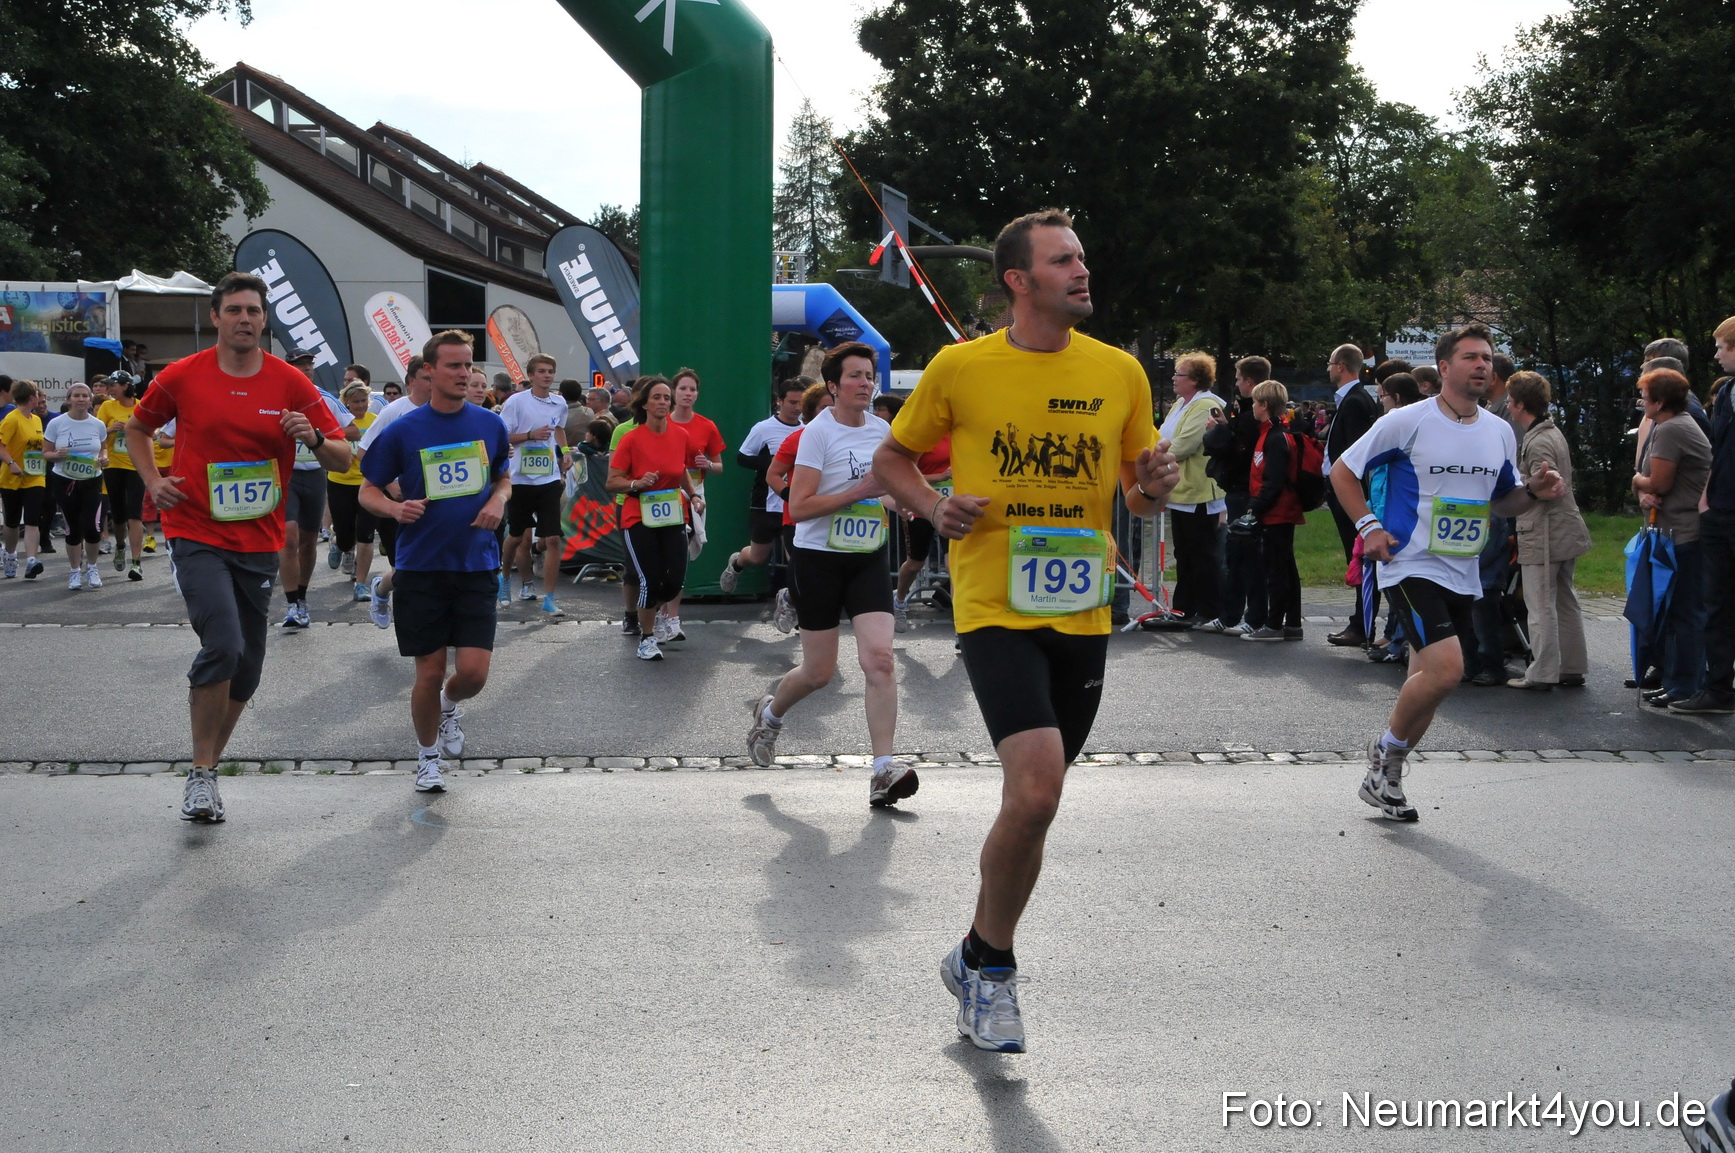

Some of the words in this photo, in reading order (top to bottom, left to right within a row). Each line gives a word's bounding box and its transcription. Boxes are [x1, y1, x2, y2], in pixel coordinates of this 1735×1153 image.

[21, 315, 91, 336] Logistics
[1047, 398, 1088, 410] swn
[26, 459, 40, 470] 181
[65, 461, 93, 475] 1006
[522, 456, 549, 468] 1360
[438, 461, 469, 484] 85
[1429, 465, 1498, 477] DELPHI
[213, 481, 272, 505] 1157
[440, 483, 465, 491] Christian
[223, 504, 251, 513] Christian
[651, 502, 671, 518] 60
[1005, 503, 1045, 517] Alles
[1050, 503, 1084, 519] läuft
[834, 516, 881, 539] 1007
[1437, 517, 1482, 541] 925
[1021, 557, 1091, 595] 193
[1030, 594, 1057, 603] Martin
